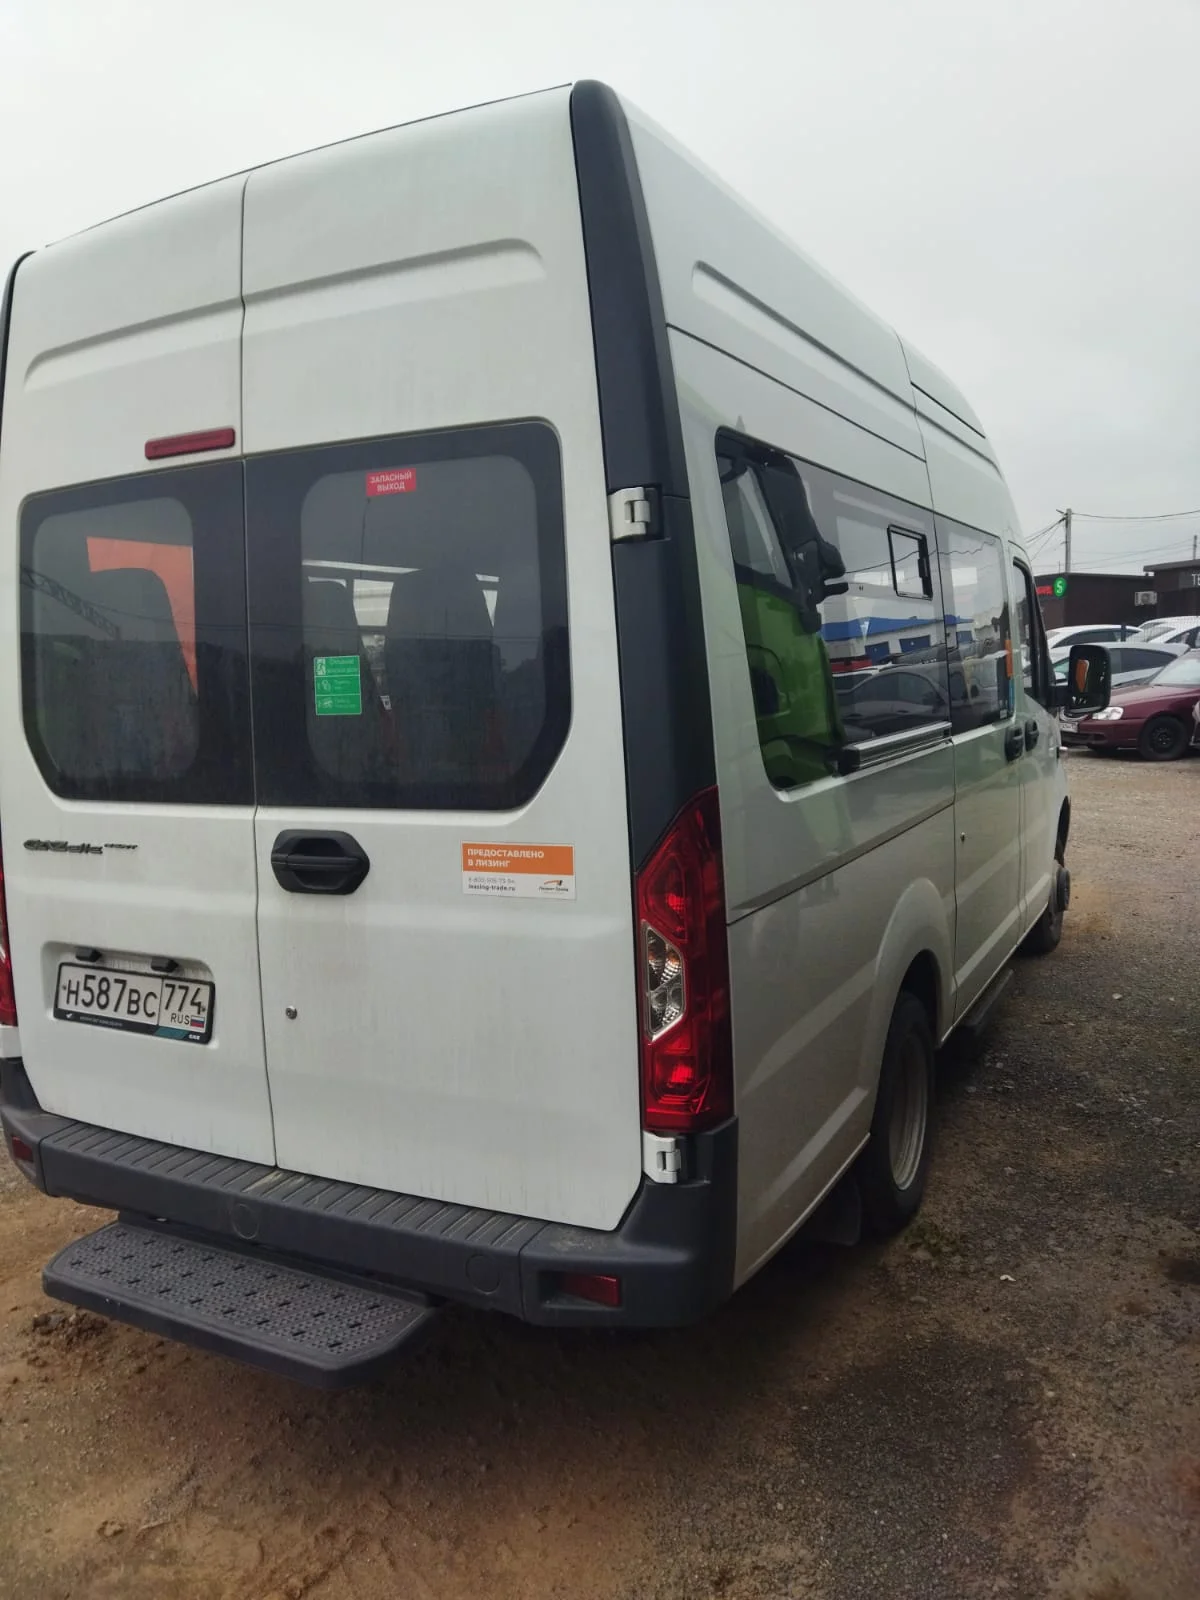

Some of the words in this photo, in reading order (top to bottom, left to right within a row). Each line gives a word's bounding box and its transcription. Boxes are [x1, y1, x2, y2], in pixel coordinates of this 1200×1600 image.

[371, 470, 412, 483] ЗАПАСНЫЙ
[377, 481, 405, 492] ВЫХОД
[467, 848, 545, 859] ПРЕДОСТАВЛЕНО
[475, 859, 510, 868] ЛИЗИНГ
[165, 983, 202, 1014] 774
[170, 1012, 190, 1024] RUS
